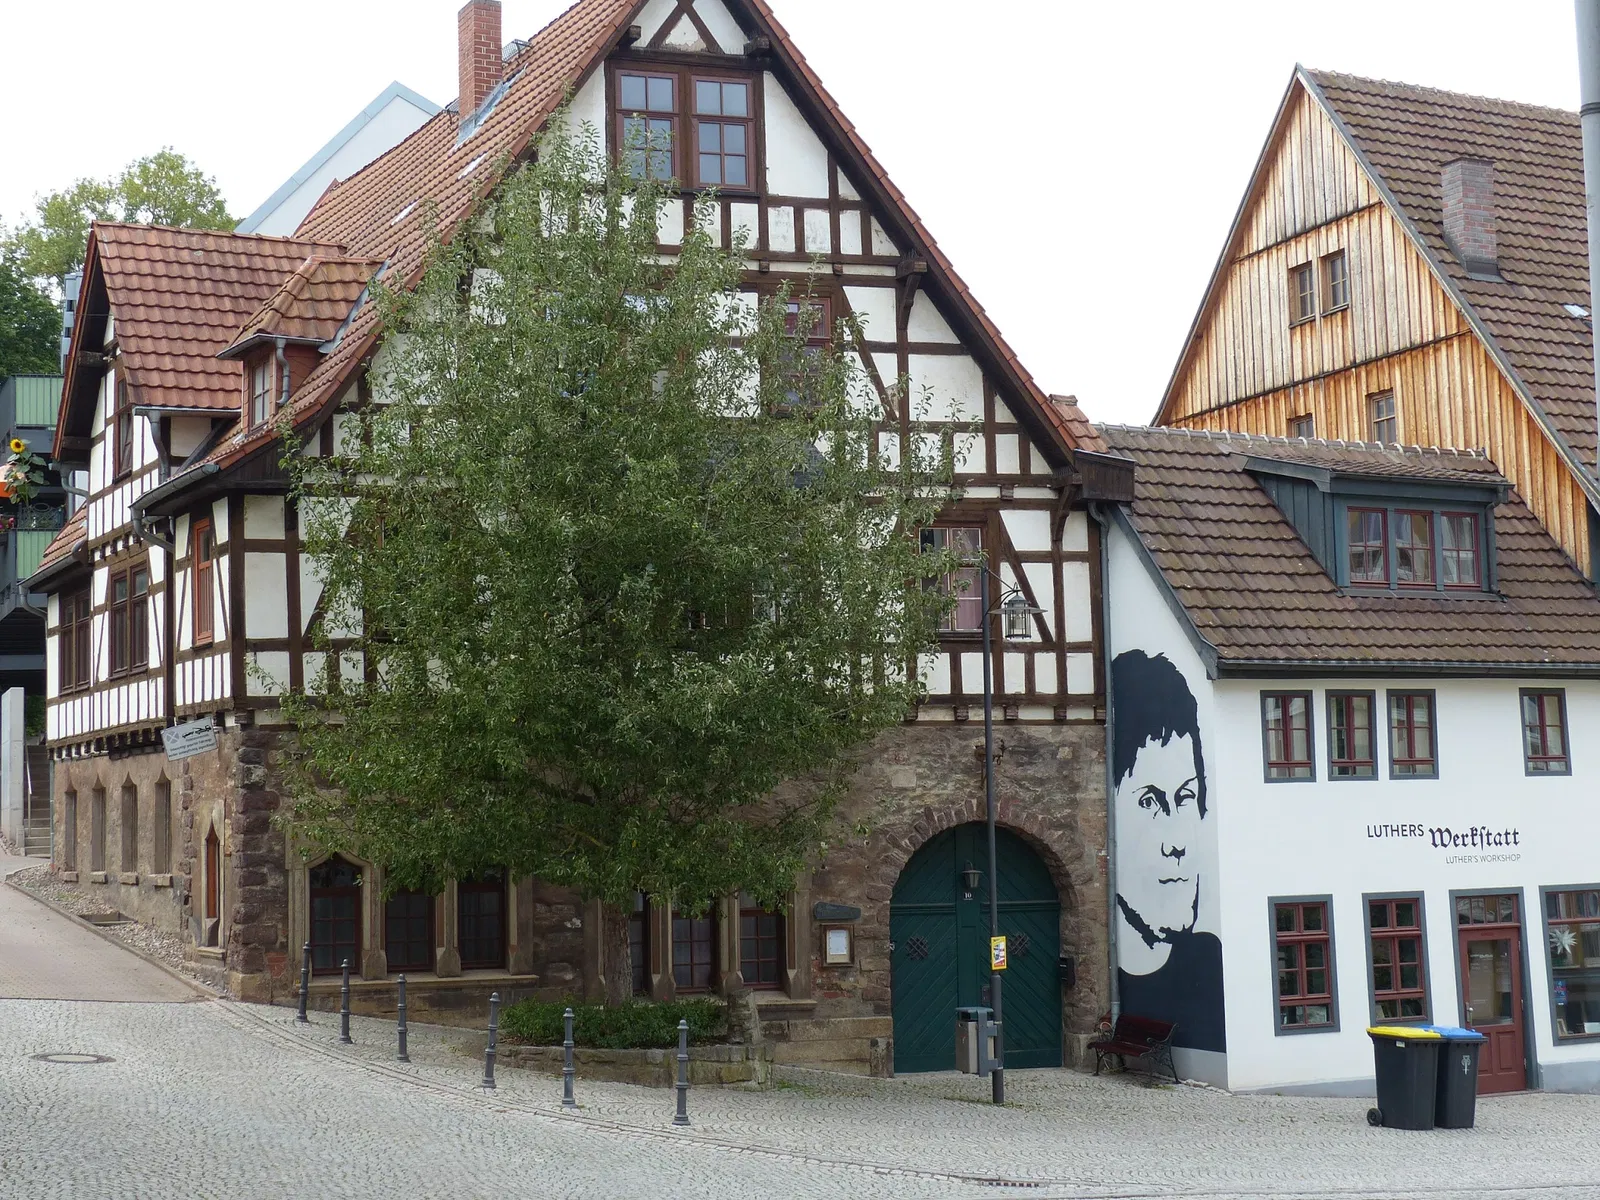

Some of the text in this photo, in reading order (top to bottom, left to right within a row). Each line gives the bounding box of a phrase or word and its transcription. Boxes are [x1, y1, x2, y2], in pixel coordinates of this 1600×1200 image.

[1367, 824, 1424, 838] LUTHERS
[1445, 853, 1521, 864] LUTHER'S WORKSHOP
